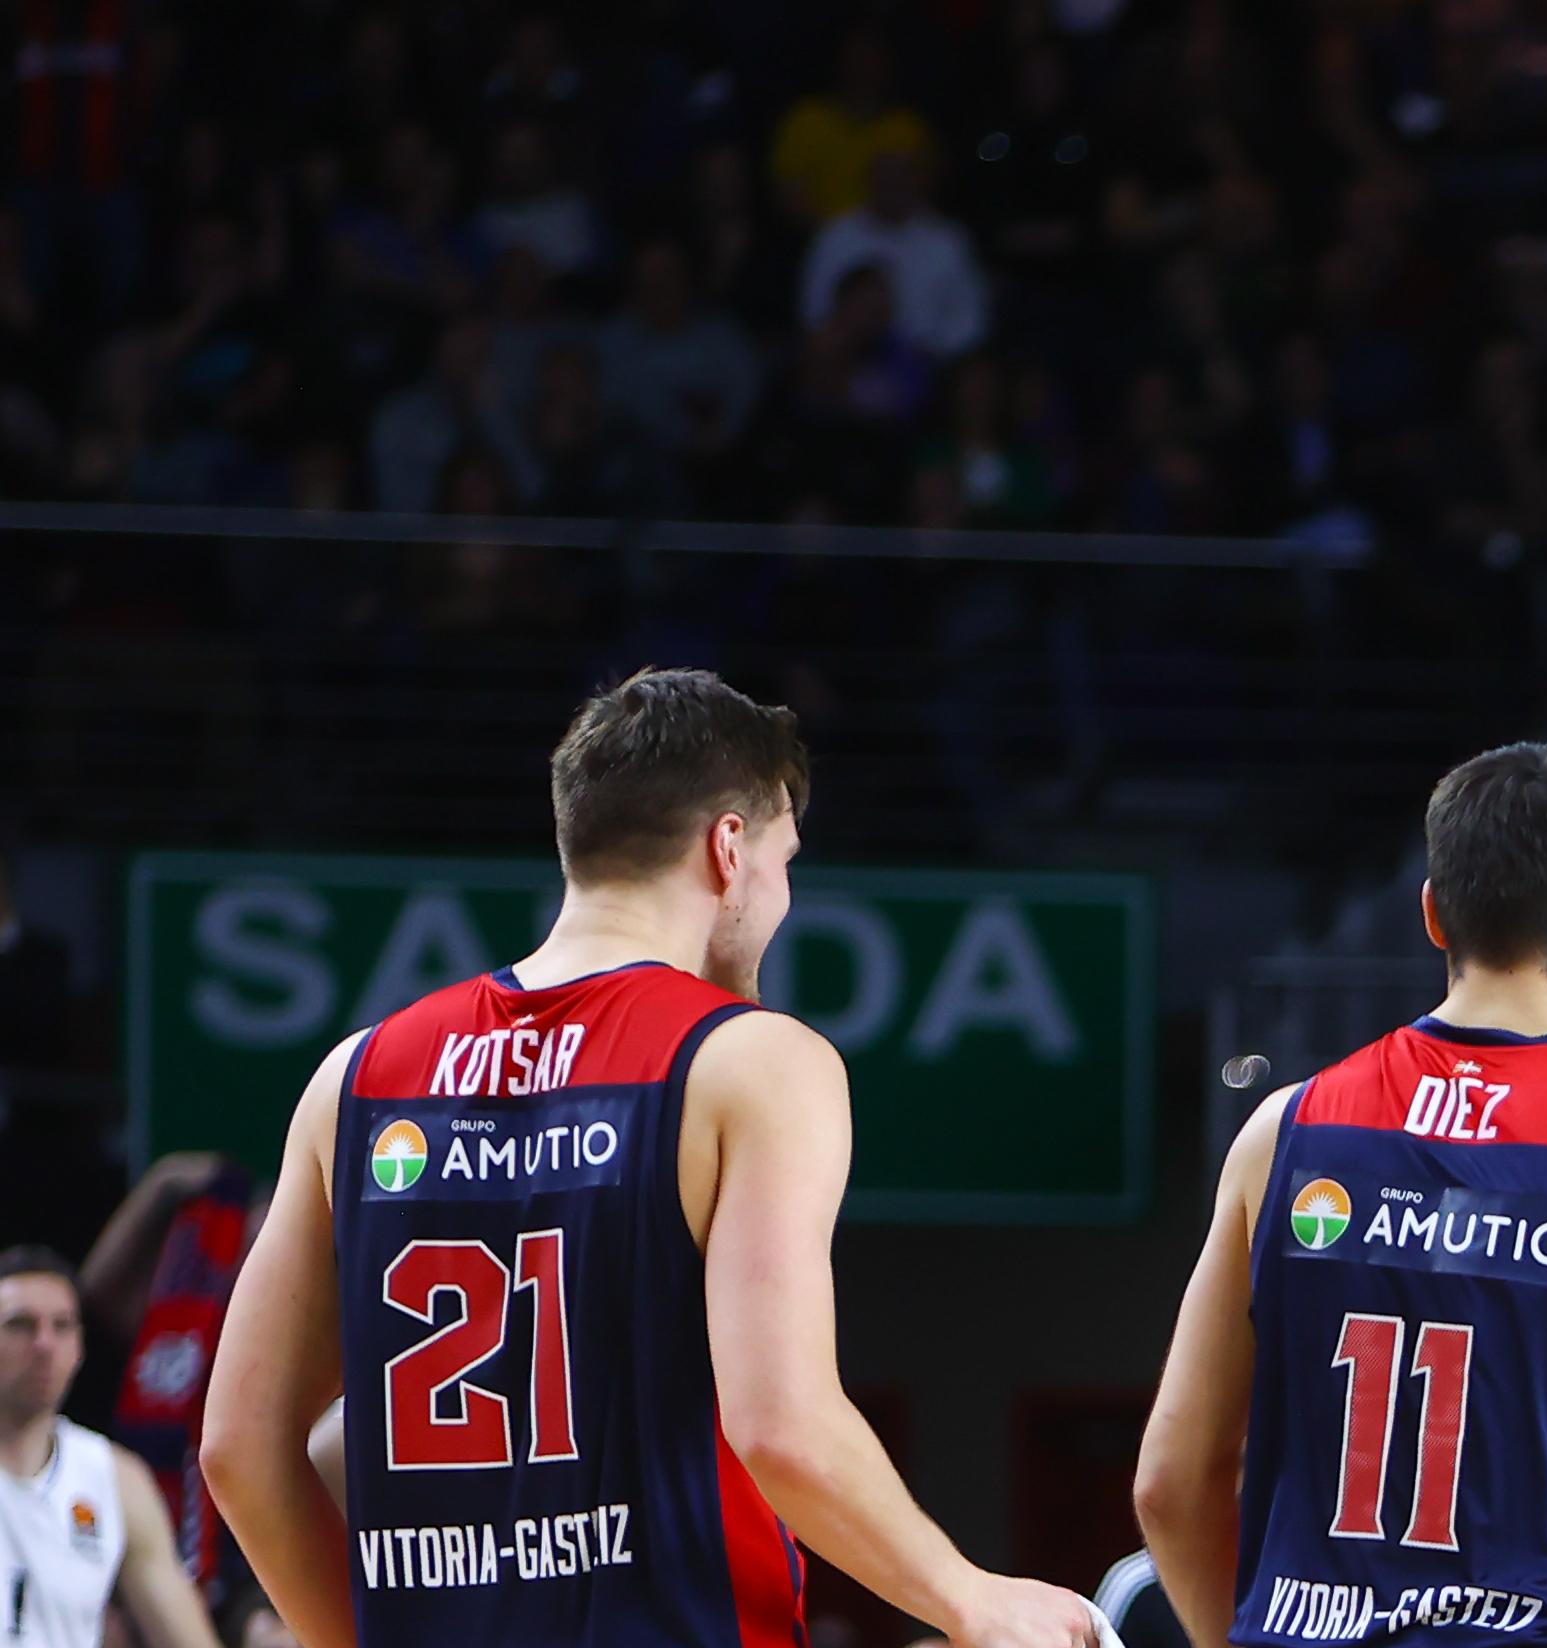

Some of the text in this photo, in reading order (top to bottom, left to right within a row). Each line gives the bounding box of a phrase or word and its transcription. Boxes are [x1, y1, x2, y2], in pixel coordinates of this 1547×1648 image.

[190, 874, 1084, 1062] SADA
[429, 1023, 586, 1096] KOTSAR
[451, 1119, 496, 1132] GRUPO
[1403, 1074, 1511, 1140] DIEZ
[441, 1121, 618, 1180] AMUTIO
[1380, 1187, 1423, 1204] GRUPO
[382, 1227, 579, 1472] 21
[1328, 1311, 1474, 1553] 11
